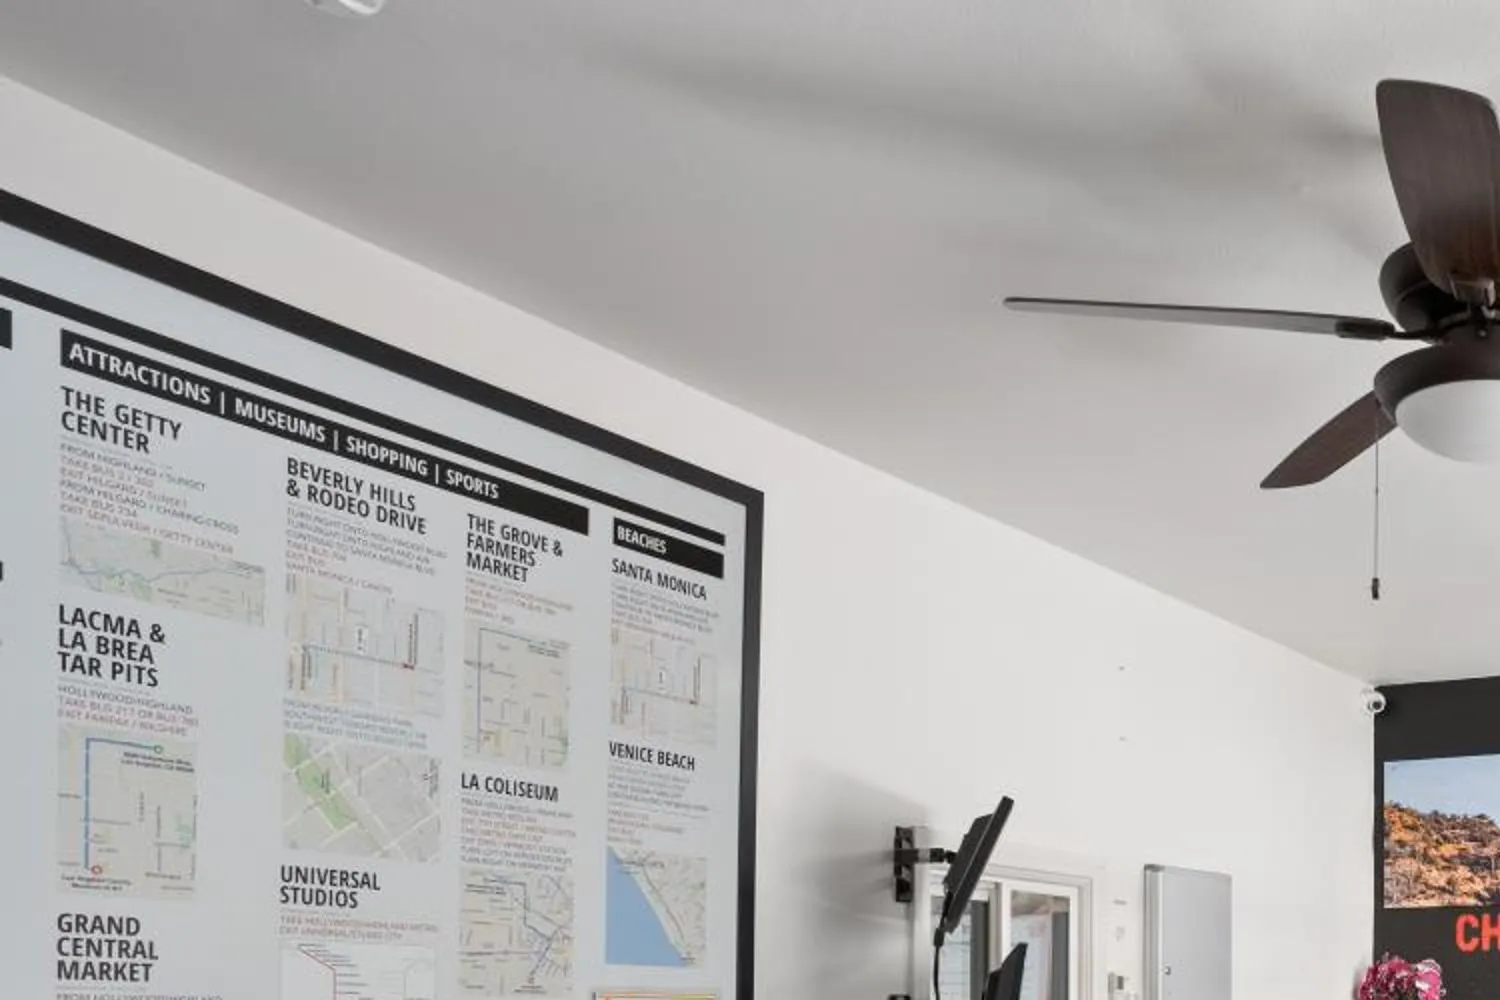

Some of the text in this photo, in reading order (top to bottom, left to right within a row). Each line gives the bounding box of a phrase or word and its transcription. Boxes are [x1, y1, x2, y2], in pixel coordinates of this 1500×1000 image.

[61, 385, 183, 440] THE GETTY
[68, 342, 211, 405] ATTRACTIONS
[235, 398, 325, 443] MUSEUMS
[347, 436, 428, 475] SHOPPING
[446, 469, 499, 499] SPORTS
[61, 411, 150, 453] CENTER
[287, 457, 416, 511] BEVERLY HILLS
[286, 479, 426, 535] & RODEO DRIVE
[467, 513, 563, 557] THE GROVE &
[467, 533, 536, 567] FARMERS
[616, 525, 667, 554] BEACHES
[466, 551, 528, 582] MARKET
[612, 558, 707, 600] SANTA MONICA
[59, 603, 166, 644] LACMA &
[58, 627, 155, 664] LA BREA
[57, 651, 159, 687] TAR PITS
[609, 741, 695, 771] VENICE BEACH
[461, 772, 559, 802] LA COLISEUM
[280, 864, 381, 890] UNIVERSAL
[280, 885, 358, 909] STUDIOS
[57, 913, 141, 936] GRAND
[56, 936, 159, 960] CENTRAL
[57, 960, 153, 982] MARKET
